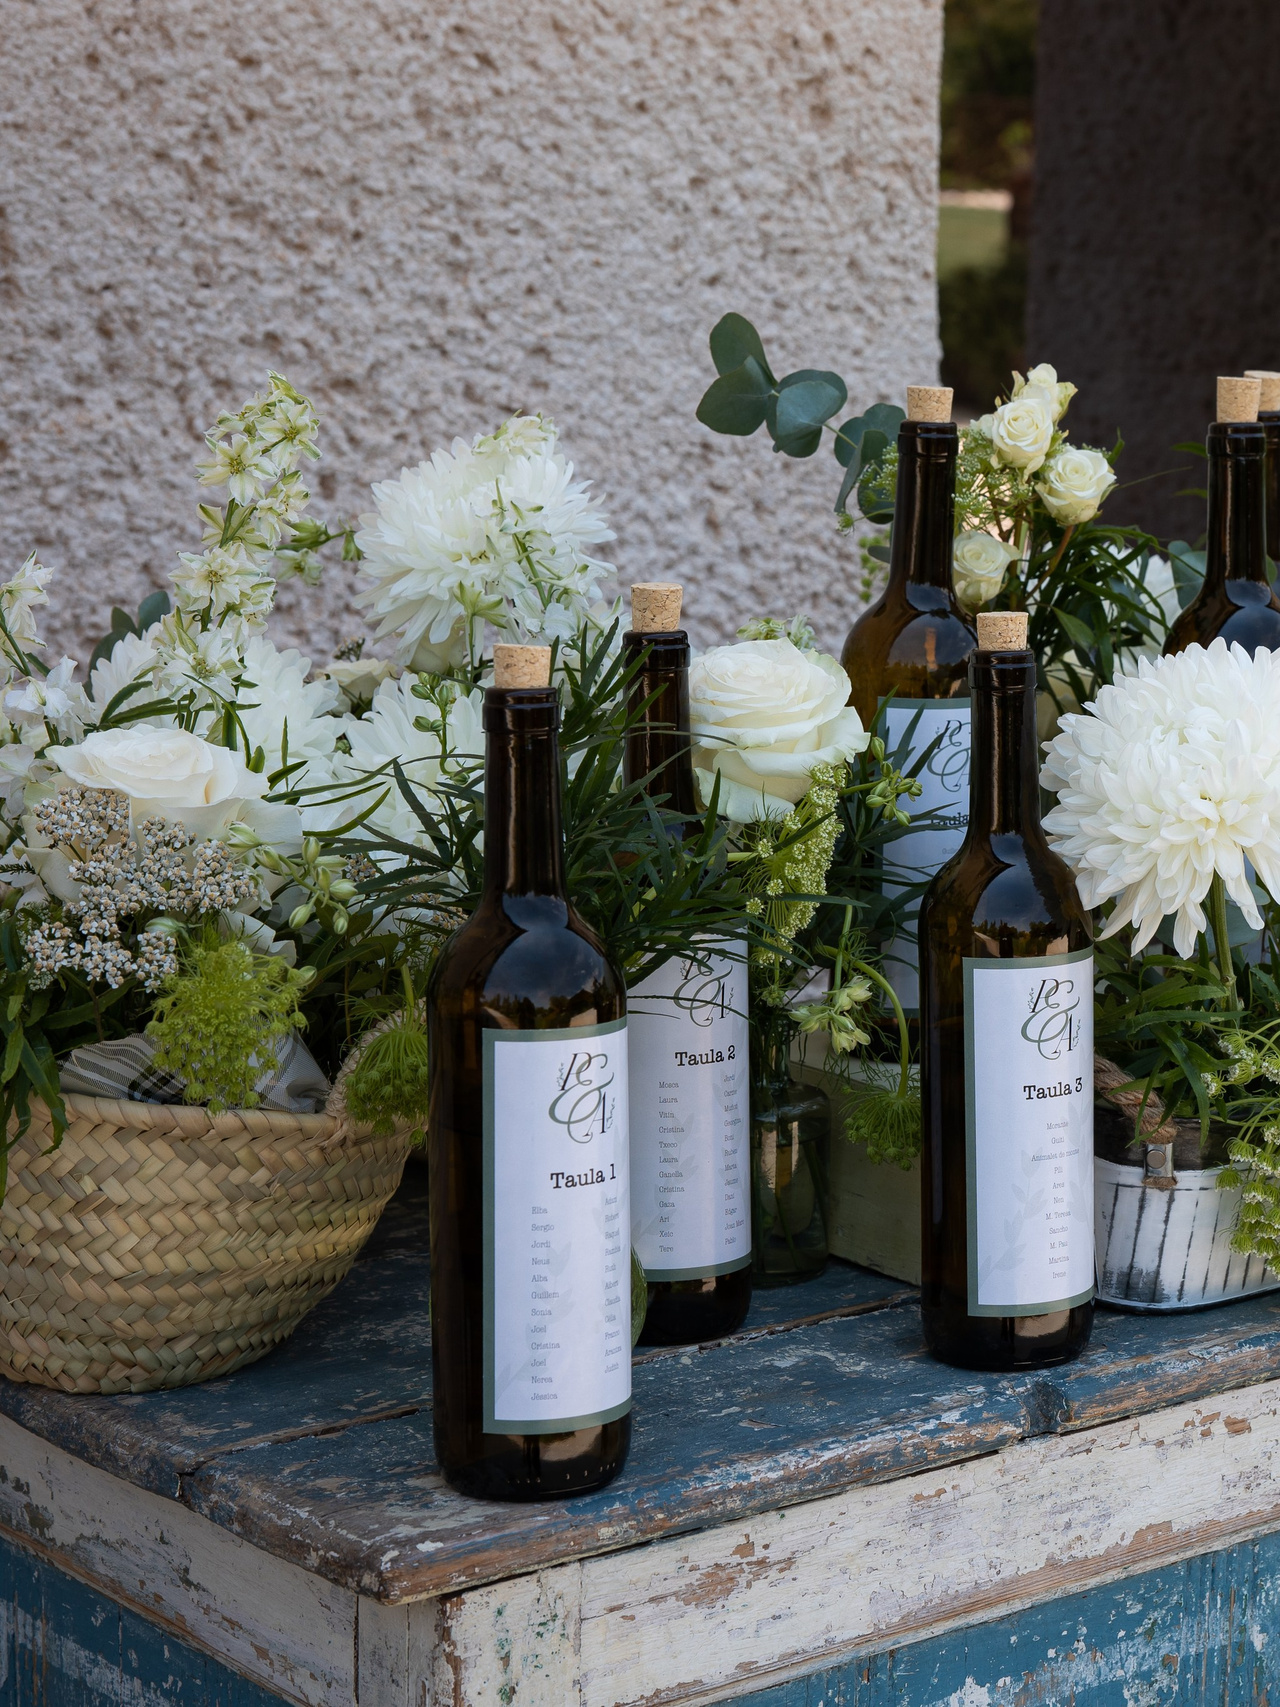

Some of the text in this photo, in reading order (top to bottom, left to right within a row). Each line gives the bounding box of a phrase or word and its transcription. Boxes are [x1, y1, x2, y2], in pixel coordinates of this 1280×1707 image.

[674, 1044, 736, 1067] Taula 2
[1023, 1076, 1083, 1101] Taula 3
[658, 1096, 679, 1104] Laura
[658, 1125, 685, 1134] Cristina
[658, 1155, 679, 1164] Laura
[550, 1162, 616, 1189] Taula 1
[658, 1185, 685, 1194] Cristina
[531, 1223, 555, 1233] Sergio
[531, 1240, 551, 1249] Jordi
[531, 1257, 550, 1266] Neus
[531, 1274, 548, 1283] Alba
[531, 1291, 560, 1300] Guillem
[531, 1325, 547, 1334] Joel
[531, 1341, 561, 1350] Cristina
[531, 1358, 547, 1368] Joel
